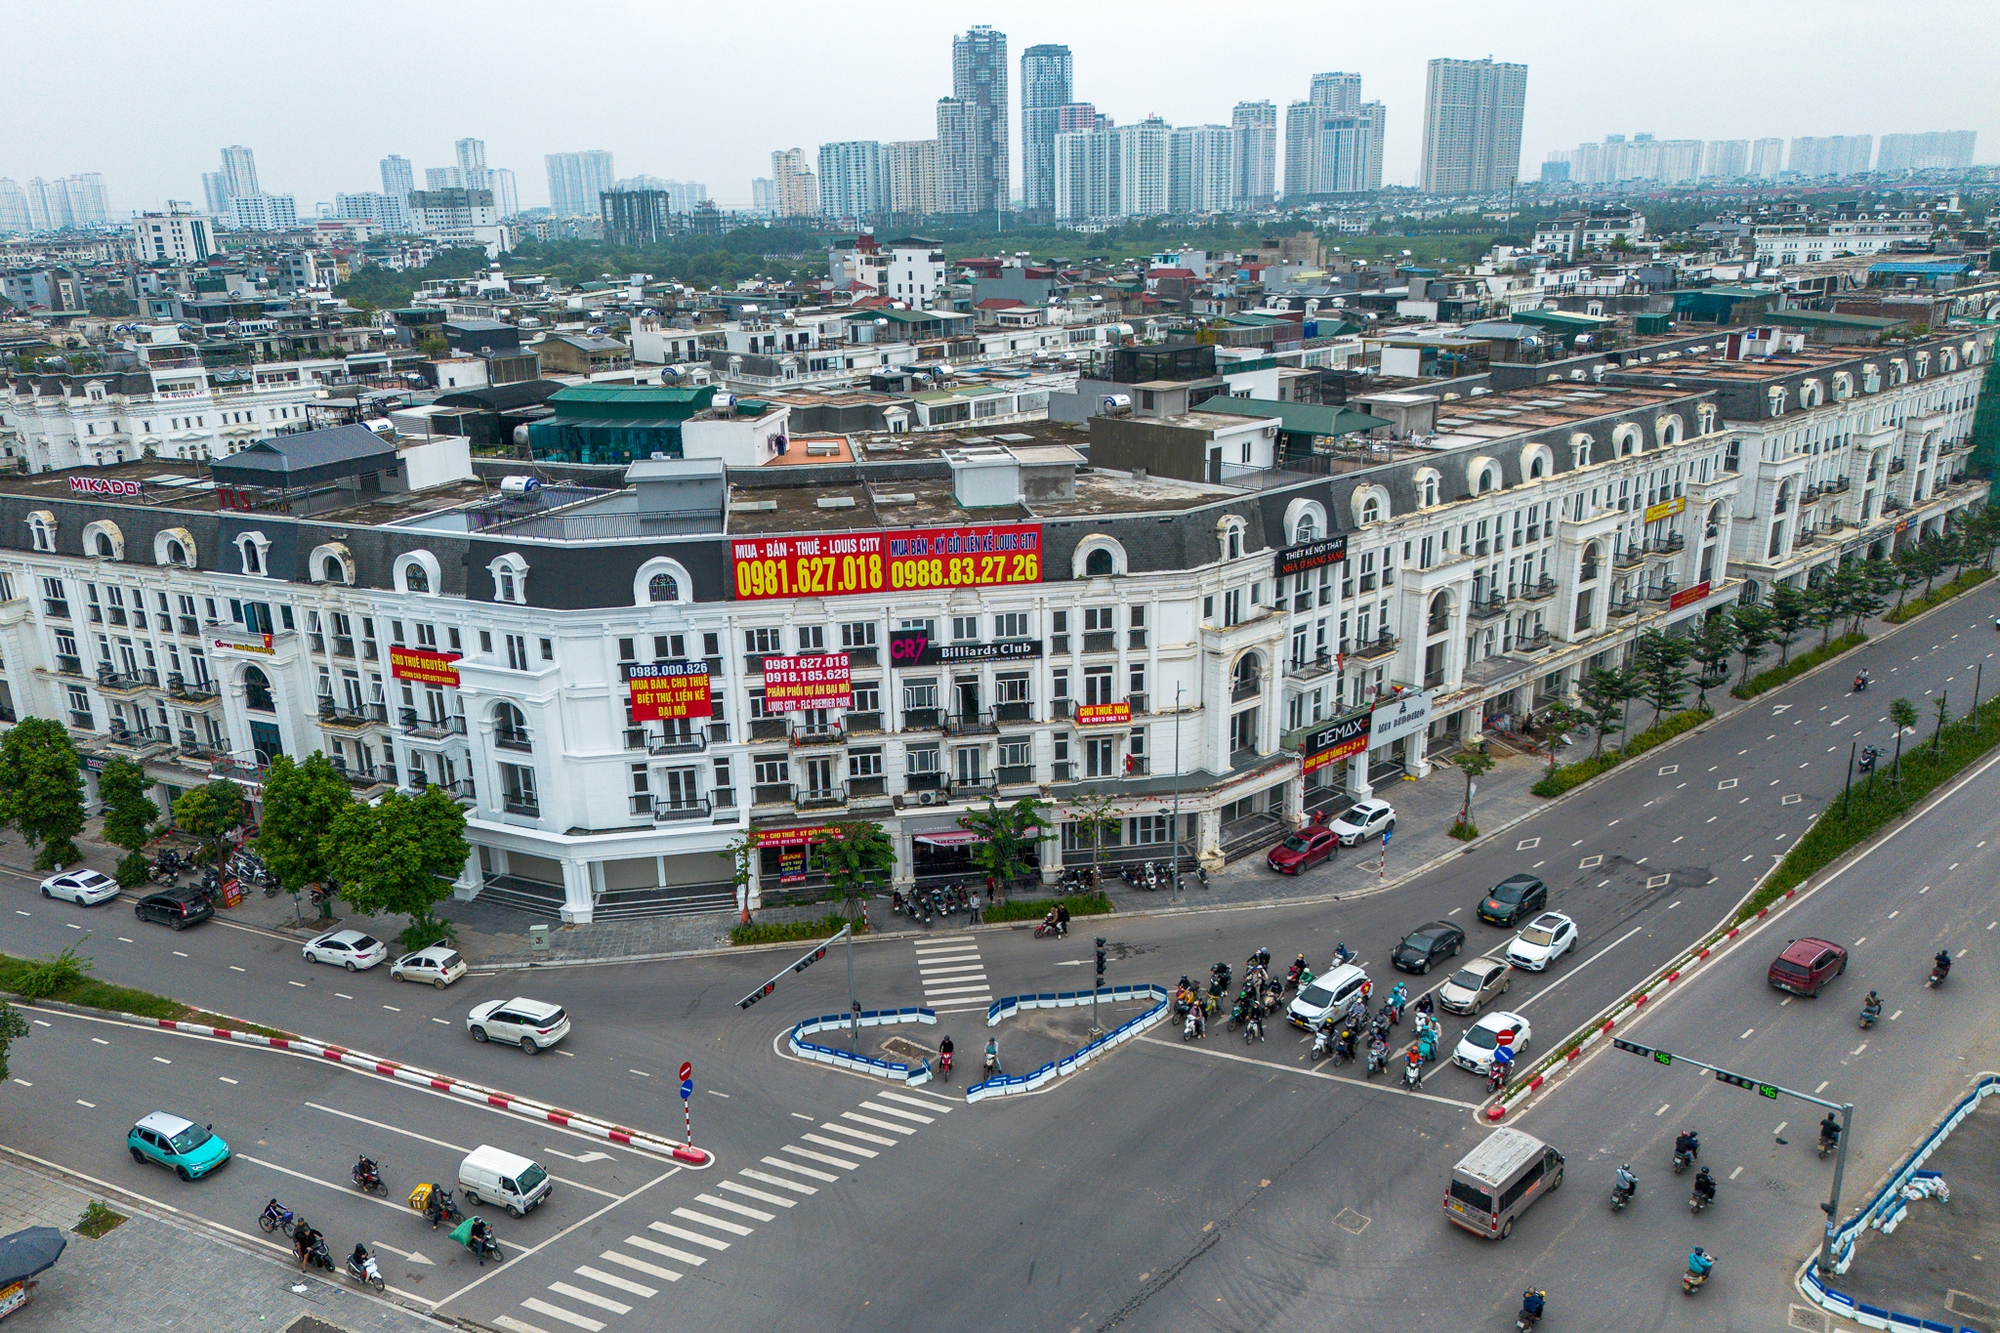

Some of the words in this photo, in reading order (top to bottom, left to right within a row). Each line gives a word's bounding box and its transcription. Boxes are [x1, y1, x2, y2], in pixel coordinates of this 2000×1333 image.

[69, 477, 137, 495] MIKADO
[216, 489, 250, 510] TLS
[735, 544, 757, 558] MUA
[766, 540, 787, 557] BÁN
[796, 538, 820, 556] THUÊ
[829, 539, 857, 554] LOUIS
[860, 538, 880, 552] CITY
[890, 540, 908, 557] MUA
[911, 535, 928, 556] BÁN
[994, 534, 1017, 551] LOUIS
[1020, 532, 1038, 549] CITY
[1286, 548, 1304, 560] THIẾT
[1305, 545, 1314, 556] KẾ
[1314, 543, 1326, 554] NỘI
[1327, 539, 1342, 550] THẤT
[1328, 550, 1344, 562] SANG
[737, 554, 882, 596] 0981.627.018
[891, 554, 1038, 588] 0988.83.27.26
[942, 645, 998, 658] Billiards
[1000, 642, 1031, 654] Club
[391, 654, 404, 666] CHO
[404, 656, 420, 668] THUÊ
[421, 658, 448, 672] NGUYÊN
[630, 663, 708, 677] 0988.000.826
[766, 656, 848, 670] 0981.627.018
[631, 680, 648, 690] MUA
[650, 677, 670, 690] BÁN,
[672, 678, 687, 688] CHO
[689, 674, 708, 686] THUÊ
[766, 668, 849, 682] 0918.185.628
[767, 686, 786, 697] PHÂN
[787, 683, 803, 696] PHỐI
[804, 685, 814, 697] DỰ
[815, 684, 824, 695] ÁN
[826, 683, 837, 696] ĐẠI
[637, 692, 654, 705] BIỆT
[768, 701, 784, 711] LOUIS
[784, 700, 796, 710] CITY
[801, 700, 810, 709] FLC
[812, 698, 835, 708] PREMIER
[836, 697, 850, 706] PARK
[658, 706, 672, 718] ĐẠI
[1080, 708, 1094, 716] CHO
[1096, 704, 1112, 716] THUÊ
[1114, 704, 1128, 714] NHÀ
[1317, 719, 1362, 748] DEMAX
[1305, 758, 1316, 768] CHO
[1316, 752, 1329, 764] THUÊ
[1344, 746, 1348, 754] 2
[1352, 742, 1356, 750] 3
[782, 830, 795, 838] THUÊ
[1656, 1052, 1670, 1064] 46
[1761, 1085, 1776, 1098] 46
